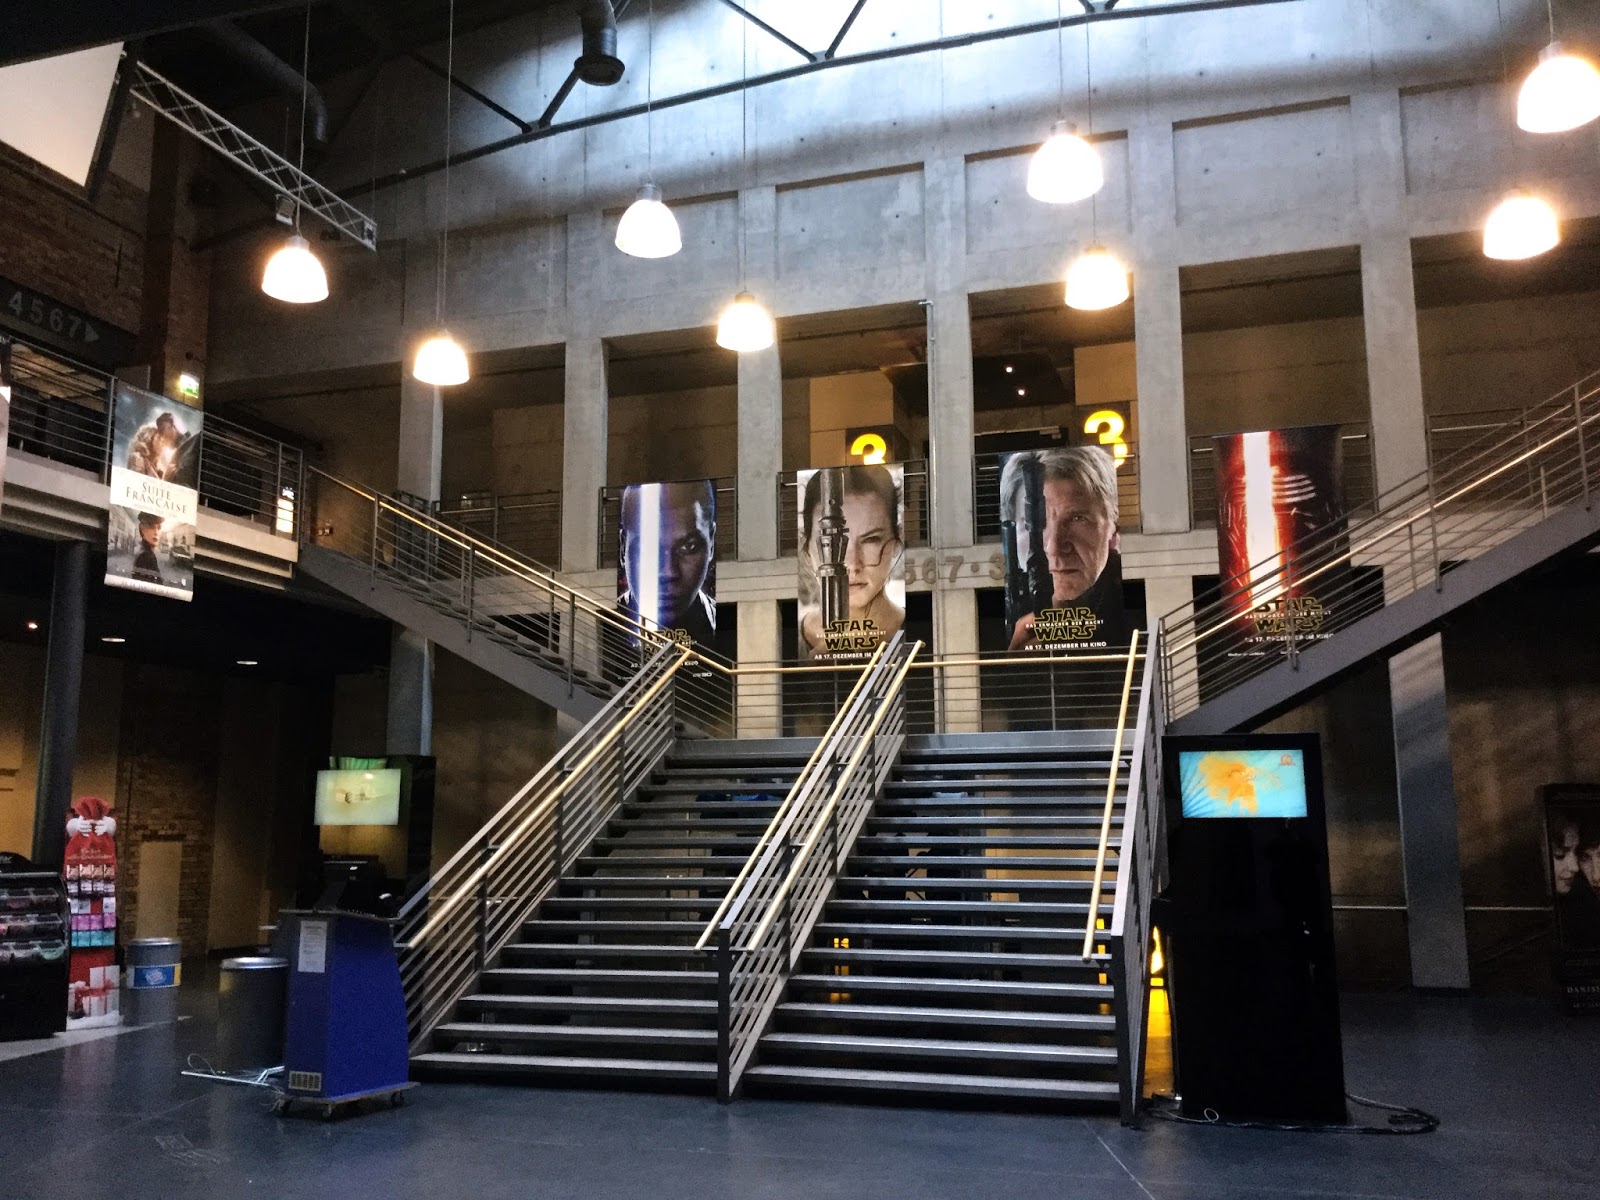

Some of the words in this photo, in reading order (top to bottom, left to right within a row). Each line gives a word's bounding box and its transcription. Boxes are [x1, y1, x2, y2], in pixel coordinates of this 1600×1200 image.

[142, 481, 171, 500] SUITE
[1034, 606, 1096, 624] STAR
[824, 619, 878, 633] STAR
[1034, 625, 1097, 641] WARS
[824, 636, 878, 651] WARS
[1044, 642, 1079, 650] DEZEMBER
[832, 652, 864, 660] DEZEMBER
